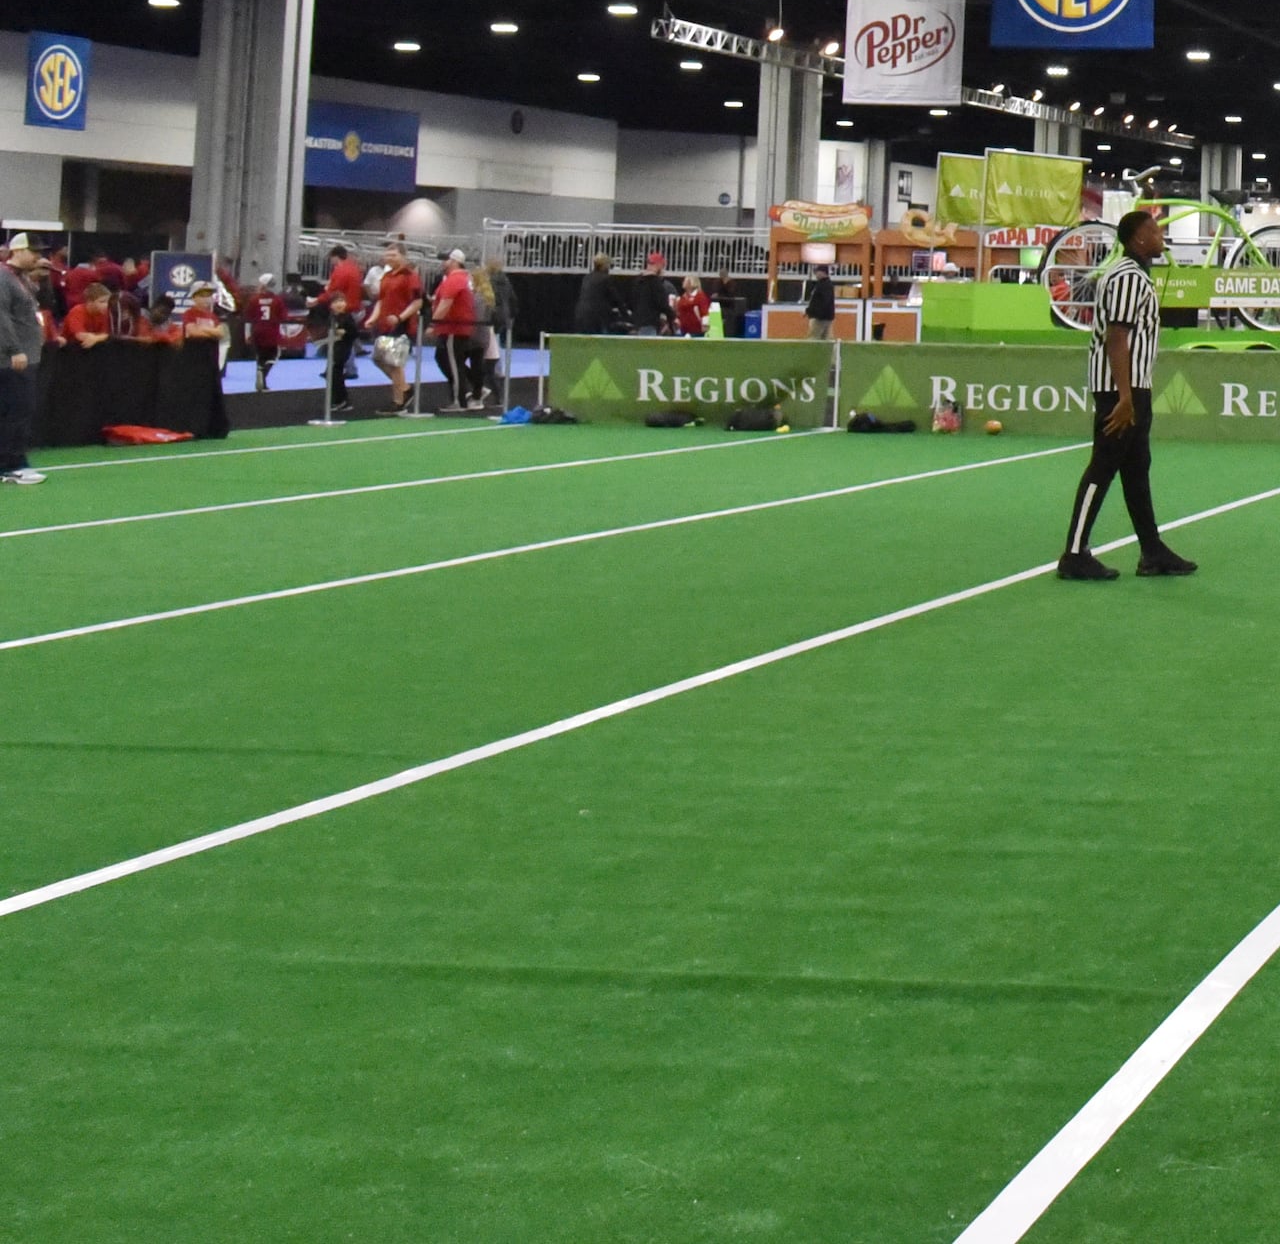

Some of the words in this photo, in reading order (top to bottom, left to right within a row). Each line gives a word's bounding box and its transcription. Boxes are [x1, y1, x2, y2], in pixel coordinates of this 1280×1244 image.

[854, 20, 949, 69] Pepper
[891, 13, 926, 42] Dr
[38, 51, 79, 112] SEC
[988, 227, 1029, 245] PAPA
[1215, 277, 1257, 294] GAME
[636, 368, 816, 404] REGIONS
[930, 375, 1094, 413] REGION
